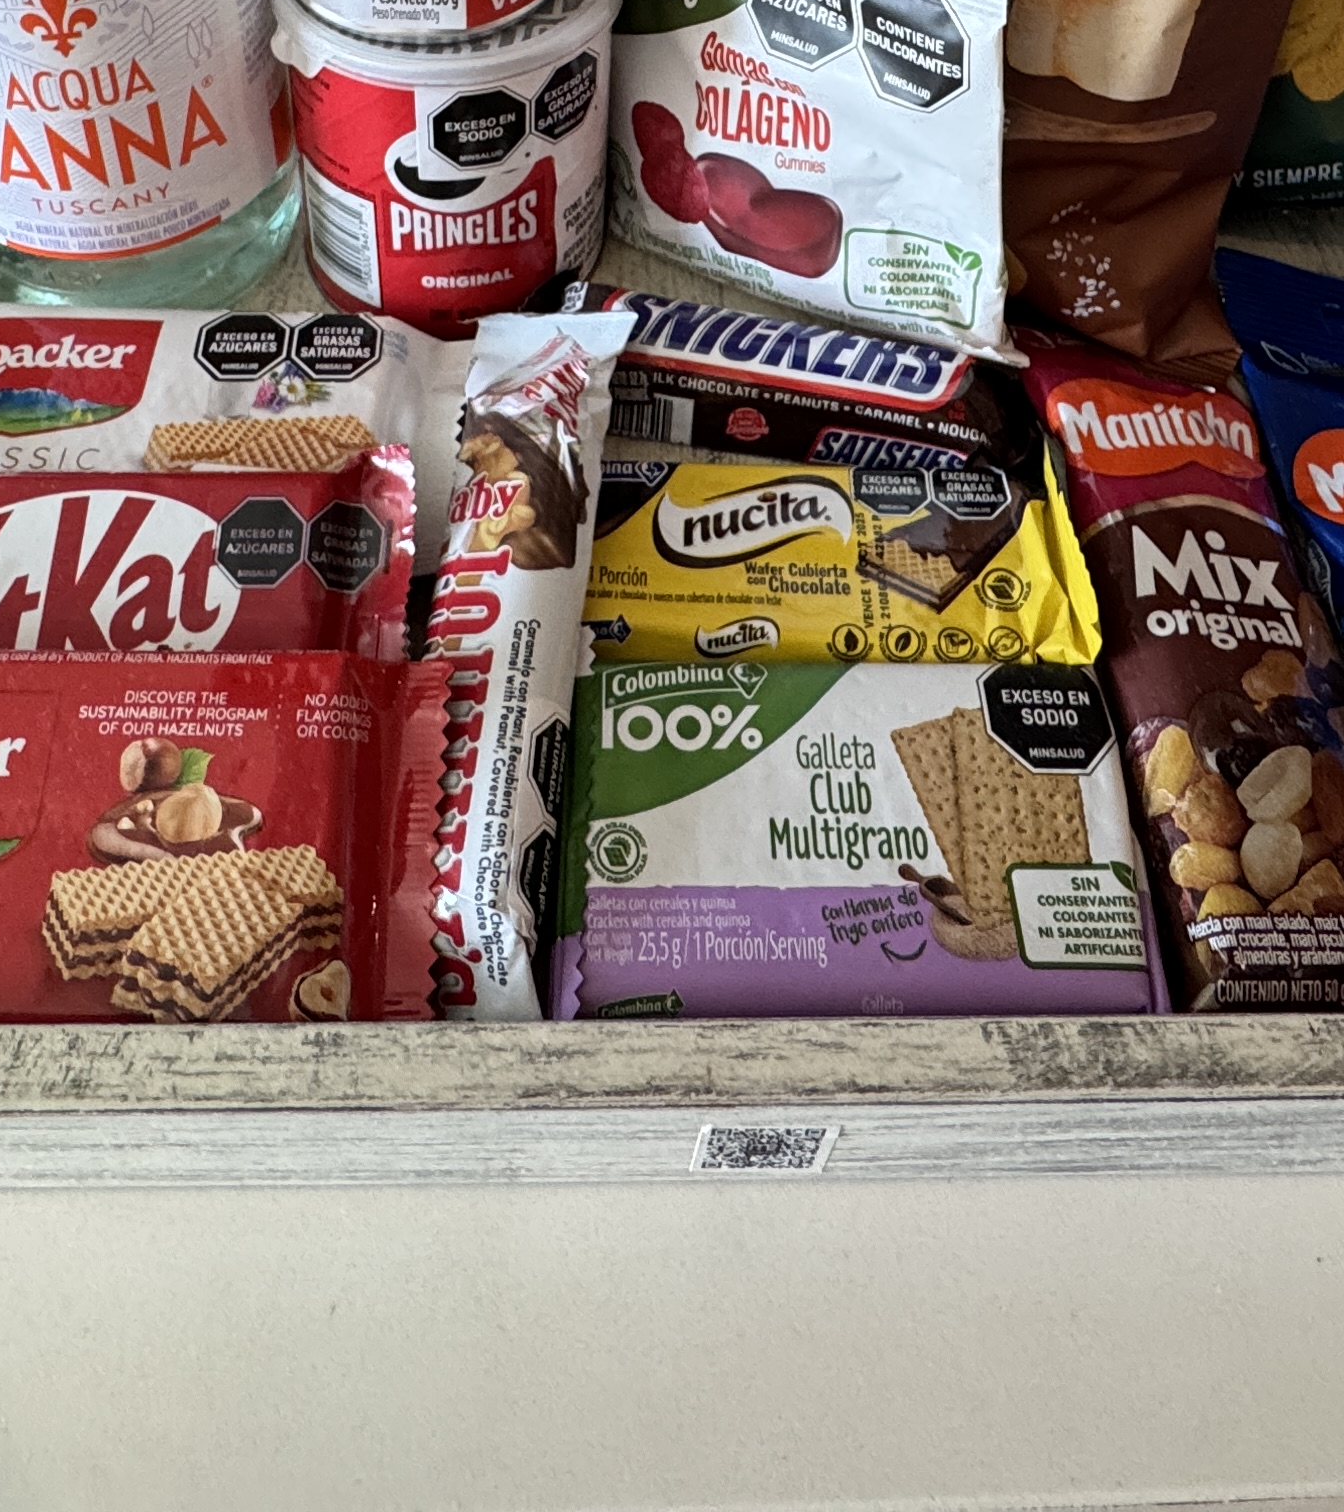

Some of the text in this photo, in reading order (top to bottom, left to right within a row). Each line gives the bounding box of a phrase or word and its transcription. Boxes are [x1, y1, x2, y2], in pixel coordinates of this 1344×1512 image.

[770, 30, 819, 56] MINSALUD
[876, 16, 945, 55] CONTIENE
[701, 31, 770, 87] Gomas
[864, 27, 962, 79] EDULCORANTES
[6, 58, 155, 112] ACQUA
[884, 72, 931, 100] MINSALUD
[445, 112, 516, 133] EXCESO EN
[458, 126, 504, 143] SODIO
[774, 153, 826, 174] Gummies
[1253, 162, 1343, 187] SIEMPRE
[32, 183, 170, 216] TUSCANY
[390, 190, 538, 251] PRINGLES
[902, 242, 929, 256] SIN
[421, 268, 514, 289] ORIGINAL
[209, 340, 278, 353] AZÚCARES
[215, 332, 258, 341] EXCESO
[313, 335, 361, 346] GRASAS
[627, 293, 956, 395] SNICKERS
[300, 346, 371, 358] SATURADAS
[678, 375, 922, 429] CHOCOLATE PEANUTS CARAMEL
[861, 484, 922, 496] AZÚCARES
[682, 492, 825, 548] nucita
[225, 541, 294, 554] AZÚCARES
[599, 565, 647, 586] Porción
[745, 562, 847, 578] Wafer Cubierta
[1132, 525, 1295, 611] Mix
[747, 575, 851, 595] con Chocolate
[861, 589, 875, 629] VENCE
[1147, 600, 1303, 651] original
[707, 624, 767, 650] nucita
[66, 653, 108, 662] PRODUCT
[111, 653, 123, 662] OF
[221, 654, 247, 663] FROM
[612, 663, 724, 695] Colombina
[124, 691, 228, 705] DISCOVER THE
[304, 694, 326, 707] NO
[1001, 688, 1090, 707] EXCESO EN
[78, 706, 268, 721] SUSTAINABILITY PROGRAM
[1020, 706, 1079, 727] SODIO
[98, 722, 244, 737] OF OUR HAZELNUTS
[297, 725, 318, 738] OR
[601, 703, 763, 752] 100%
[796, 733, 876, 771] Galleta
[1028, 746, 1085, 760] MINSALUD
[474, 620, 527, 982] Caramel with Covered with Chocolate Flavor
[489, 619, 541, 987] Caramelo con Recubierto con Sabor Chocolate
[810, 771, 872, 815] Club
[769, 816, 929, 870] Multigrano
[1072, 877, 1101, 891] SIN
[629, 897, 647, 910] con
[1037, 895, 1139, 908] CONSERVANTES,
[631, 914, 653, 928] with
[656, 914, 691, 928] cereals
[693, 914, 712, 928] and
[1053, 911, 1135, 923] COLORANTES
[1187, 913, 1314, 941] Mezcla con salado,
[1038, 927, 1054, 938] NI
[638, 931, 670, 966] 25,5
[672, 938, 682, 969] g
[706, 928, 828, 969] Porción/Serving
[1064, 943, 1143, 957] ARTIFICIALES
[1218, 979, 1321, 1003] CONTENIDO NETO
